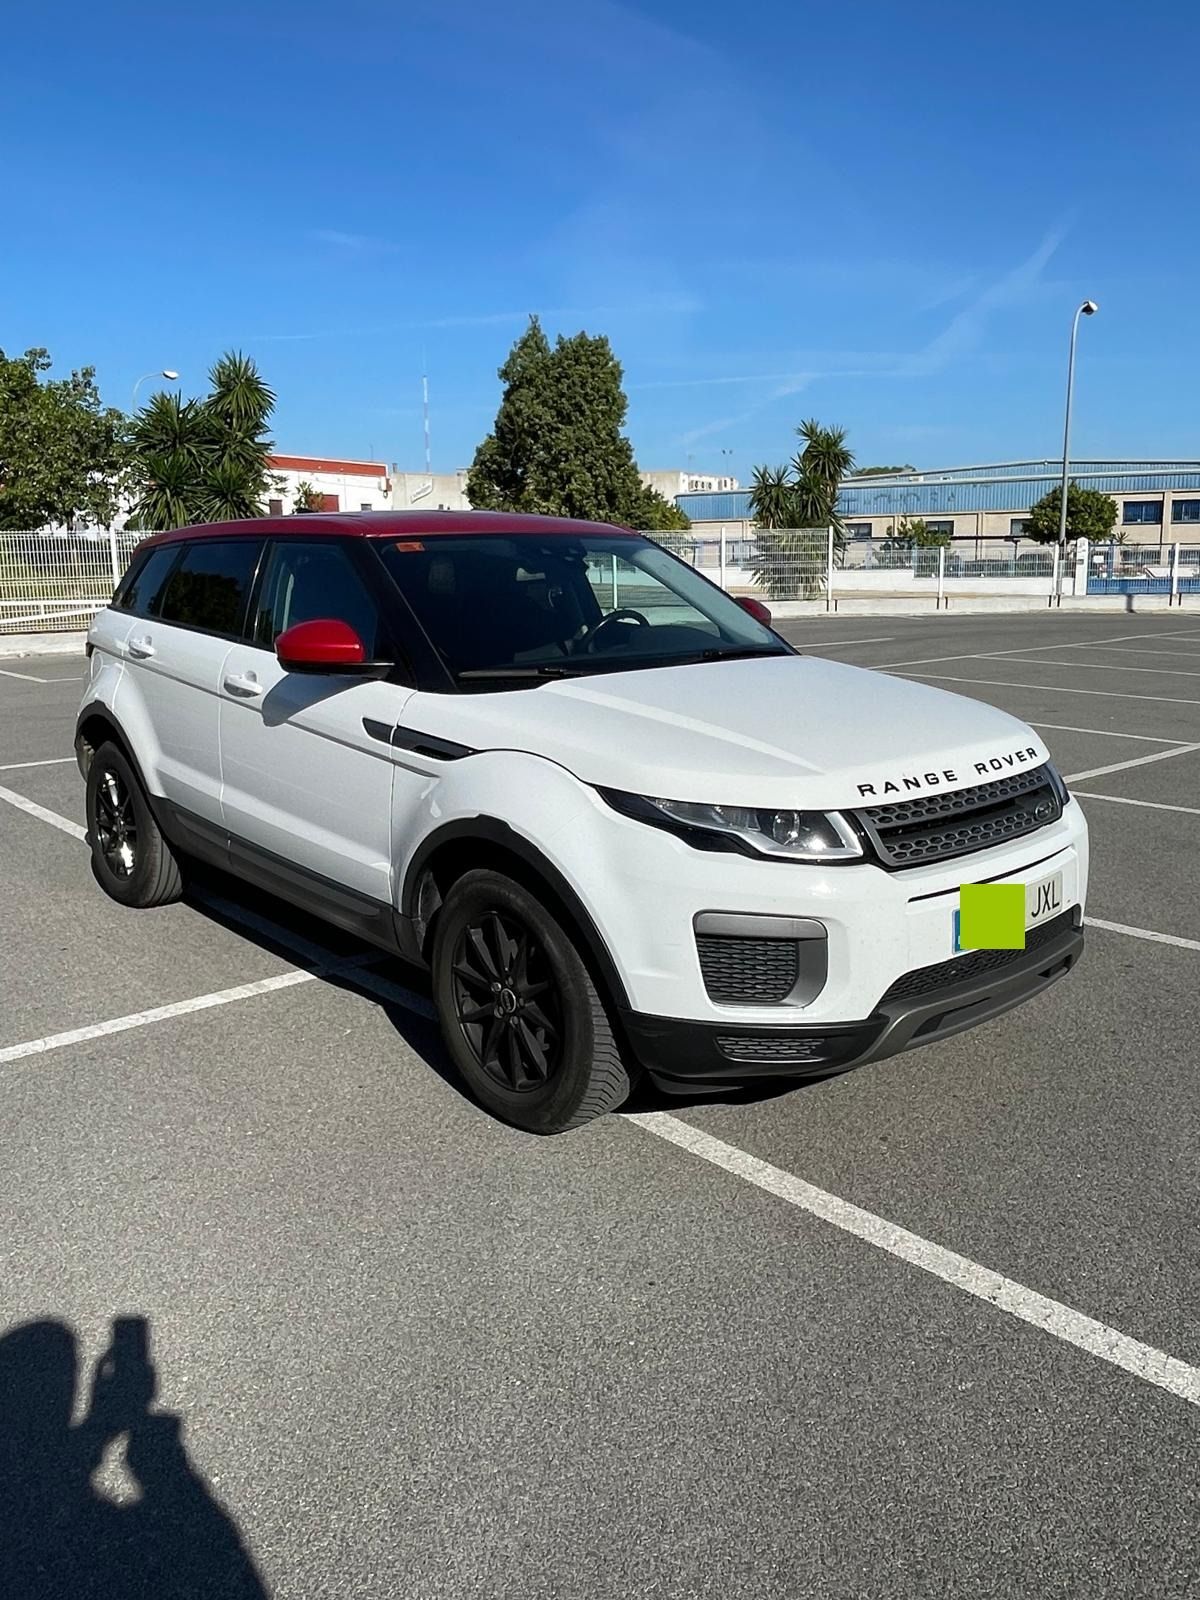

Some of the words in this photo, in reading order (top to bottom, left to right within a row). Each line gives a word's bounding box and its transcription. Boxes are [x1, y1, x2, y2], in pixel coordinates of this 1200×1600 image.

[857, 770, 958, 797] RANGE
[974, 747, 1038, 775] ROVER
[1031, 880, 1060, 917] JXL
